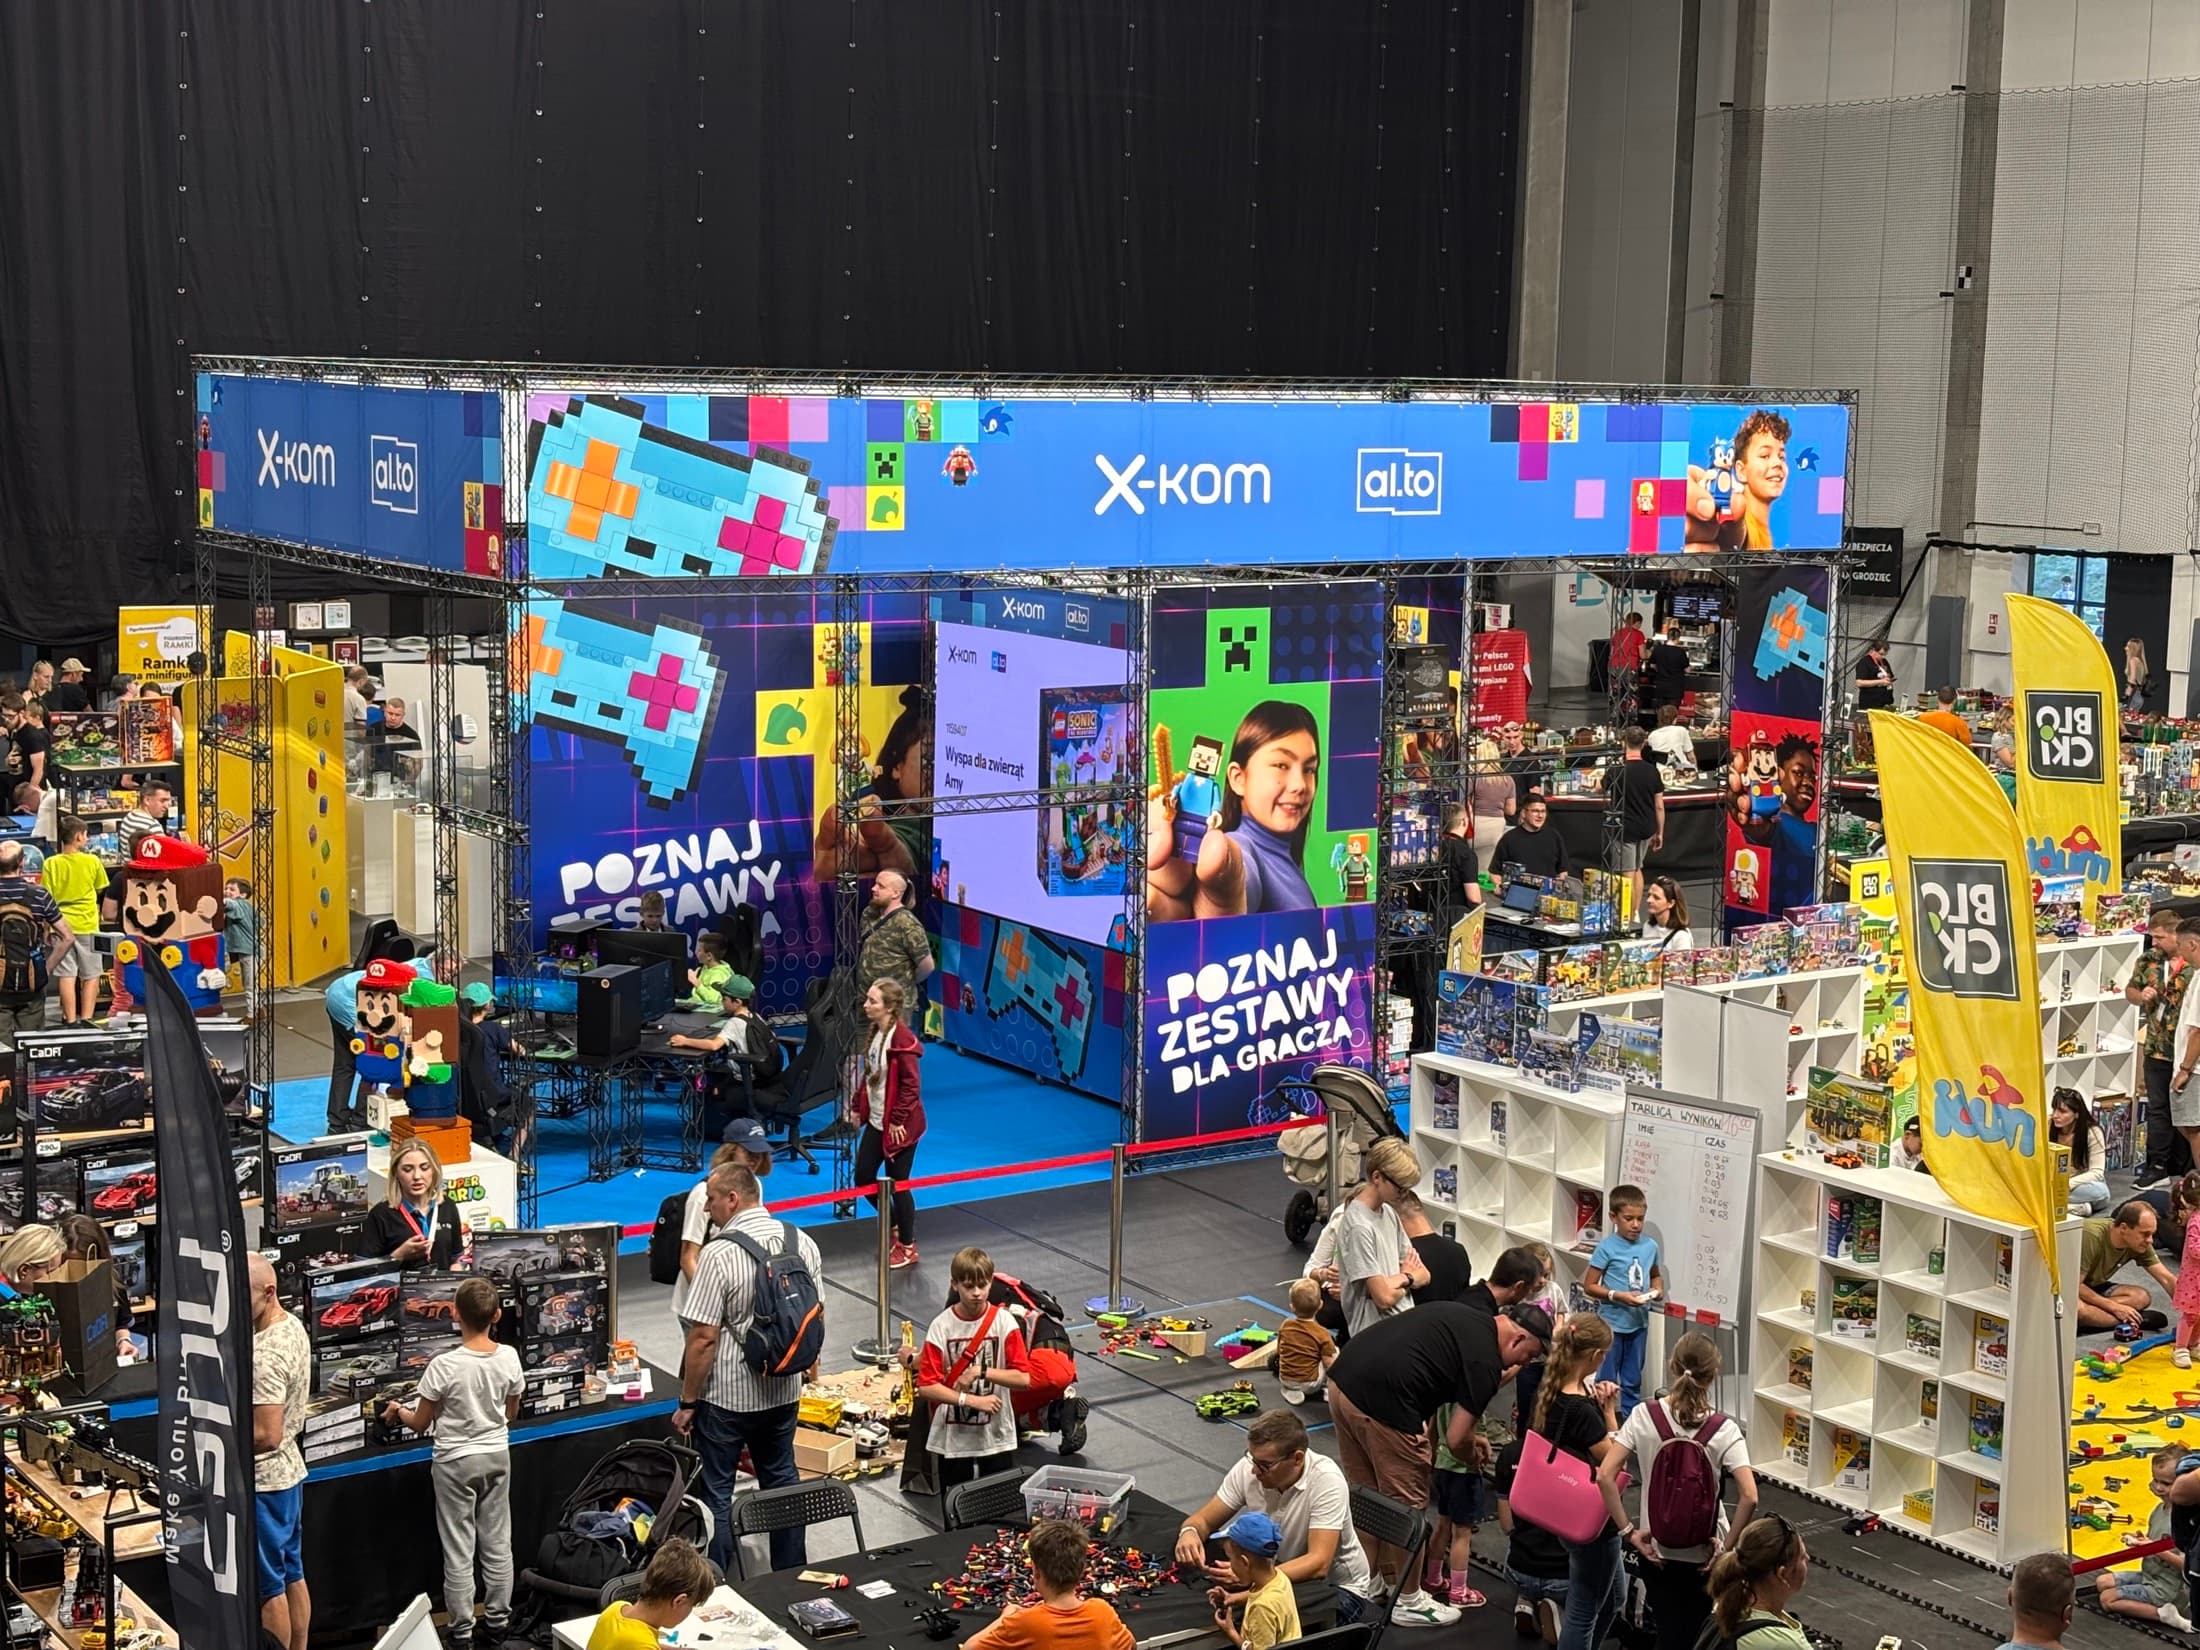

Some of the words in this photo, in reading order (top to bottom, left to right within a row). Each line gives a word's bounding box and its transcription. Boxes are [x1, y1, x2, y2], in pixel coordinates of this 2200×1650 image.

[143, 656, 187, 670] Ramk
[145, 669, 193, 681] minifigur
[945, 745, 972, 768] Wyspa
[974, 752, 986, 769] dla
[988, 757, 1024, 781] zwierząt
[945, 772, 963, 794] Amy
[560, 819, 762, 905] POZNAJ
[1167, 929, 1337, 1014] POZNAJ
[1158, 967, 1354, 1062] ZESTAWY
[1171, 1058, 1231, 1093] DLA
[1236, 1015, 1353, 1072] GRACZA
[1631, 1101, 1673, 1119] TABLICA
[1705, 1137, 1727, 1149] CZAS
[448, 1186, 486, 1201] ARIO
